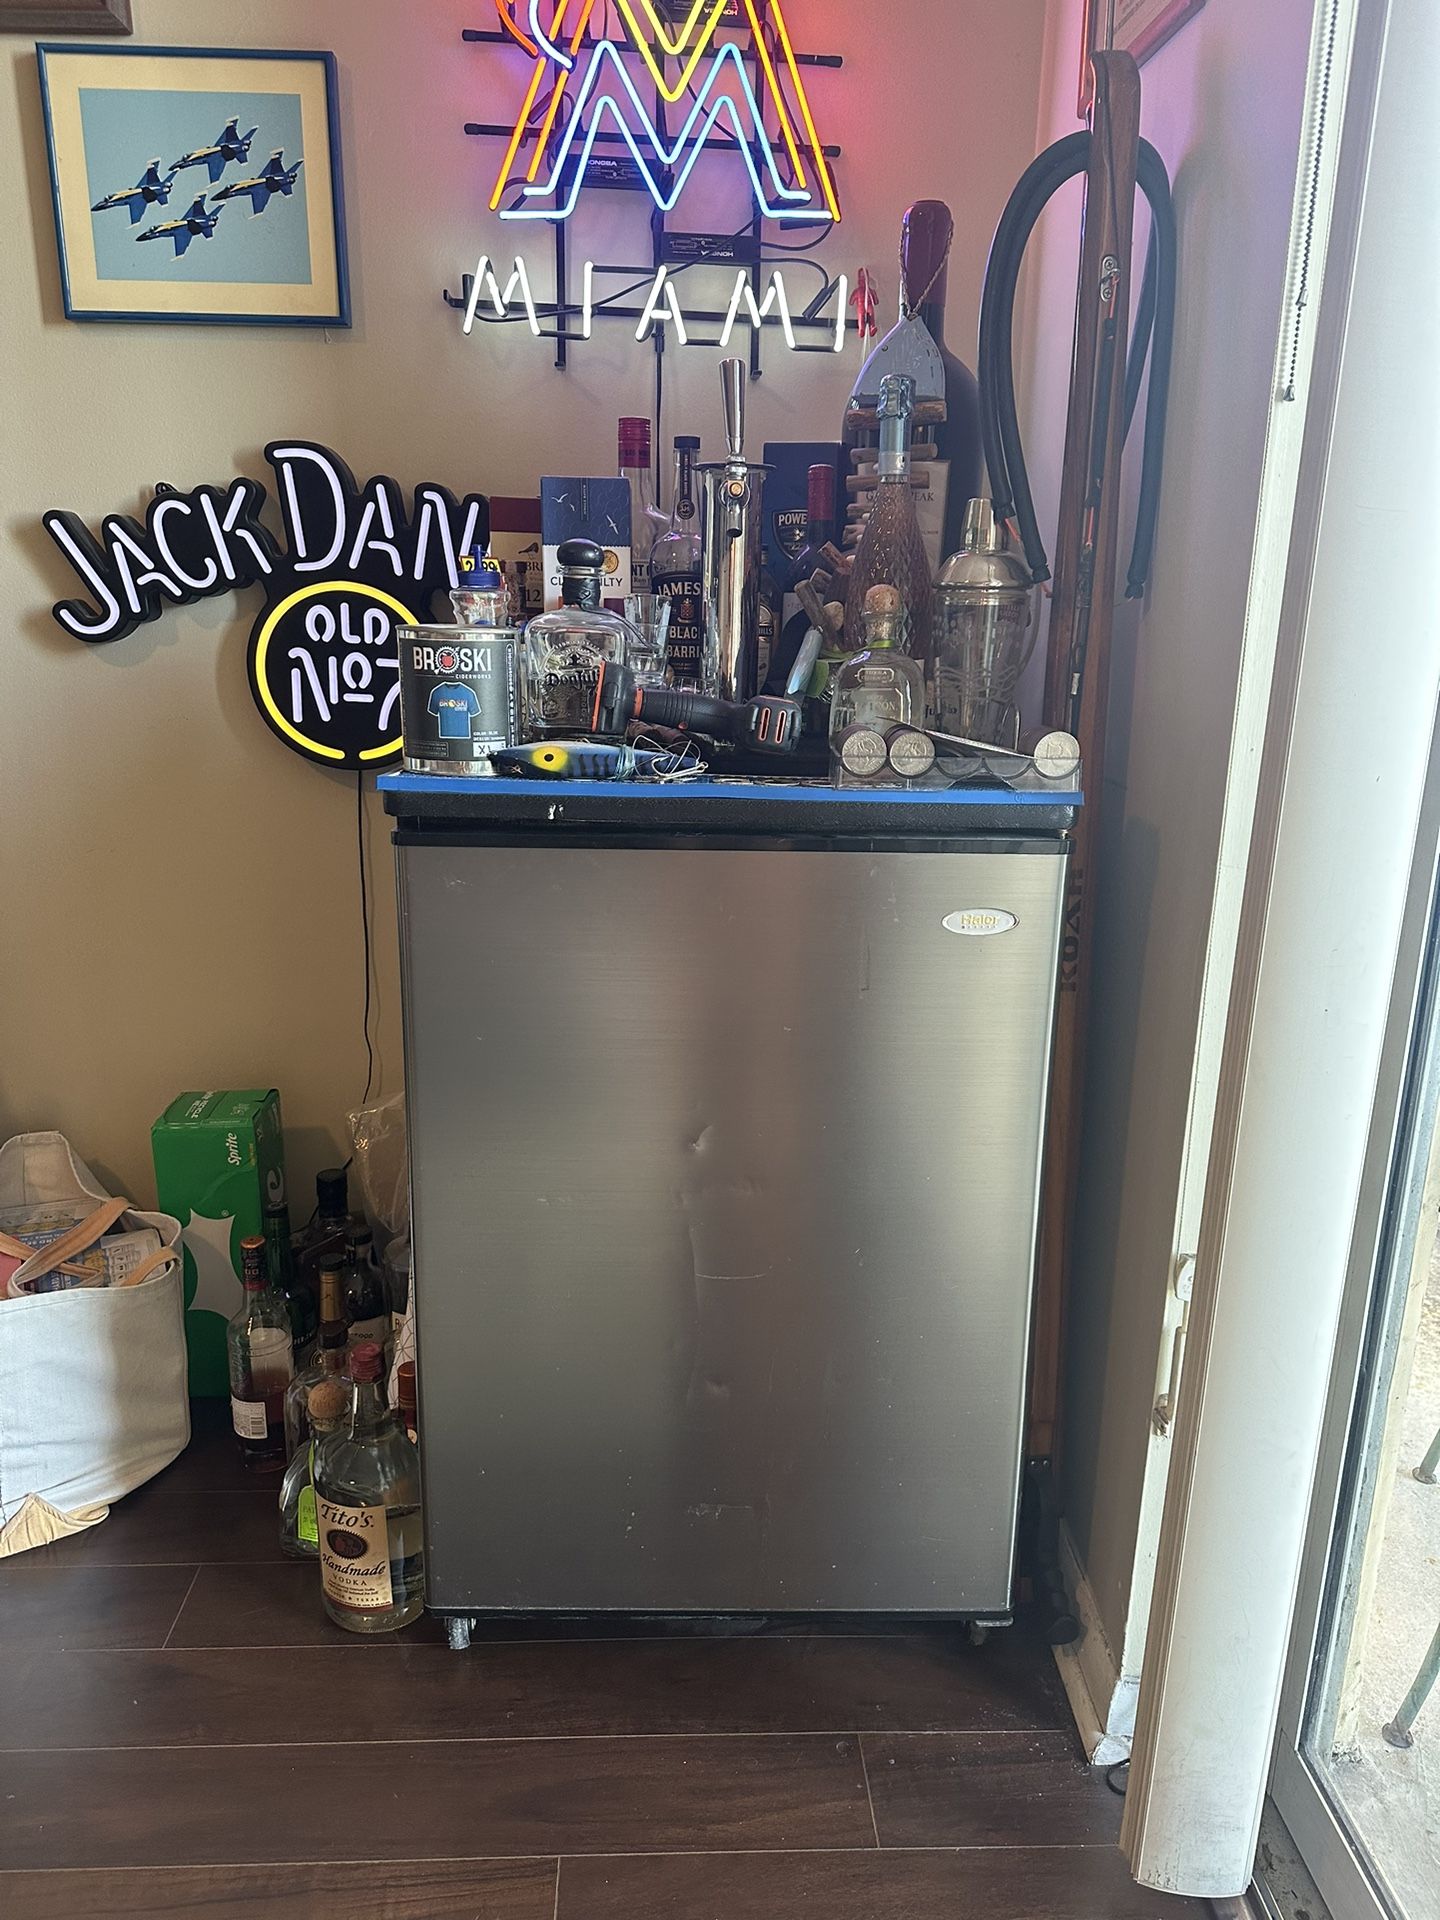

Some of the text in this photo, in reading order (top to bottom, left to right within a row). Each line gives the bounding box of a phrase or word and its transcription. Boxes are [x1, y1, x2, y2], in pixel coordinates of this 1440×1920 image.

[462, 254, 849, 353] MIAMI
[48, 485, 273, 635] JACK
[550, 576, 624, 587] CLILTY
[305, 602, 390, 645] OLD
[669, 625, 701, 639] BLAC
[225, 1132, 242, 1166] Sprite
[322, 1552, 386, 1577] Handmade
[332, 1573, 368, 1586] VODKA
